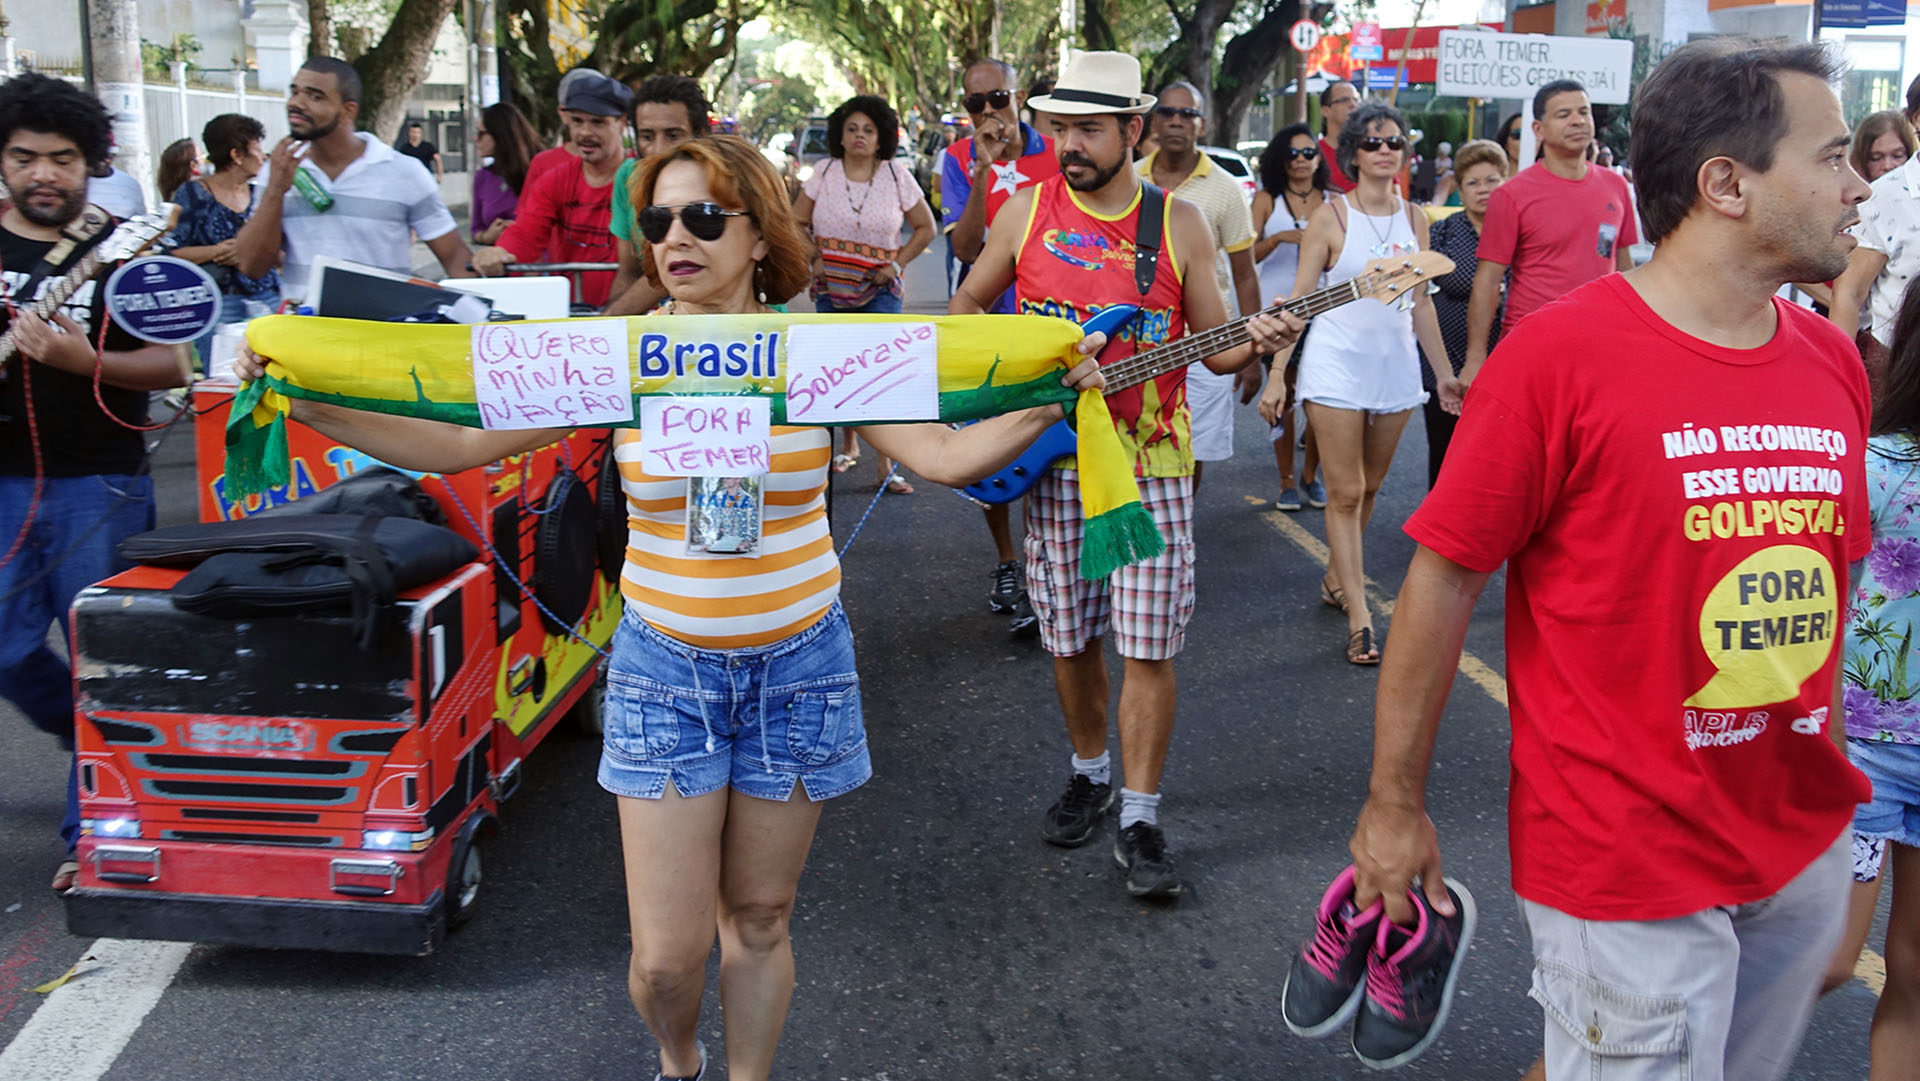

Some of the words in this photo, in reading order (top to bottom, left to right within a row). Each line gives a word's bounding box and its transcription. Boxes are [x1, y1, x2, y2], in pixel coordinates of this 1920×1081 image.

[1444, 37, 1486, 59] FORA
[1444, 61, 1521, 87] ELEIÇÕES
[479, 325, 610, 364] QUERO
[640, 332, 779, 378] Brasil
[480, 390, 625, 428] NAÇÃO
[662, 405, 752, 437] FORA
[1662, 422, 1718, 459] NÃO
[1720, 424, 1847, 461] RECONHEÇO
[1682, 468, 1741, 499] ESSE
[1742, 466, 1843, 496] GOVERNO
[1684, 499, 1846, 541] GOLPISTA!
[1738, 567, 1825, 605] FORA
[1714, 609, 1832, 650] TEMER!
[190, 723, 297, 745] SCANIA
